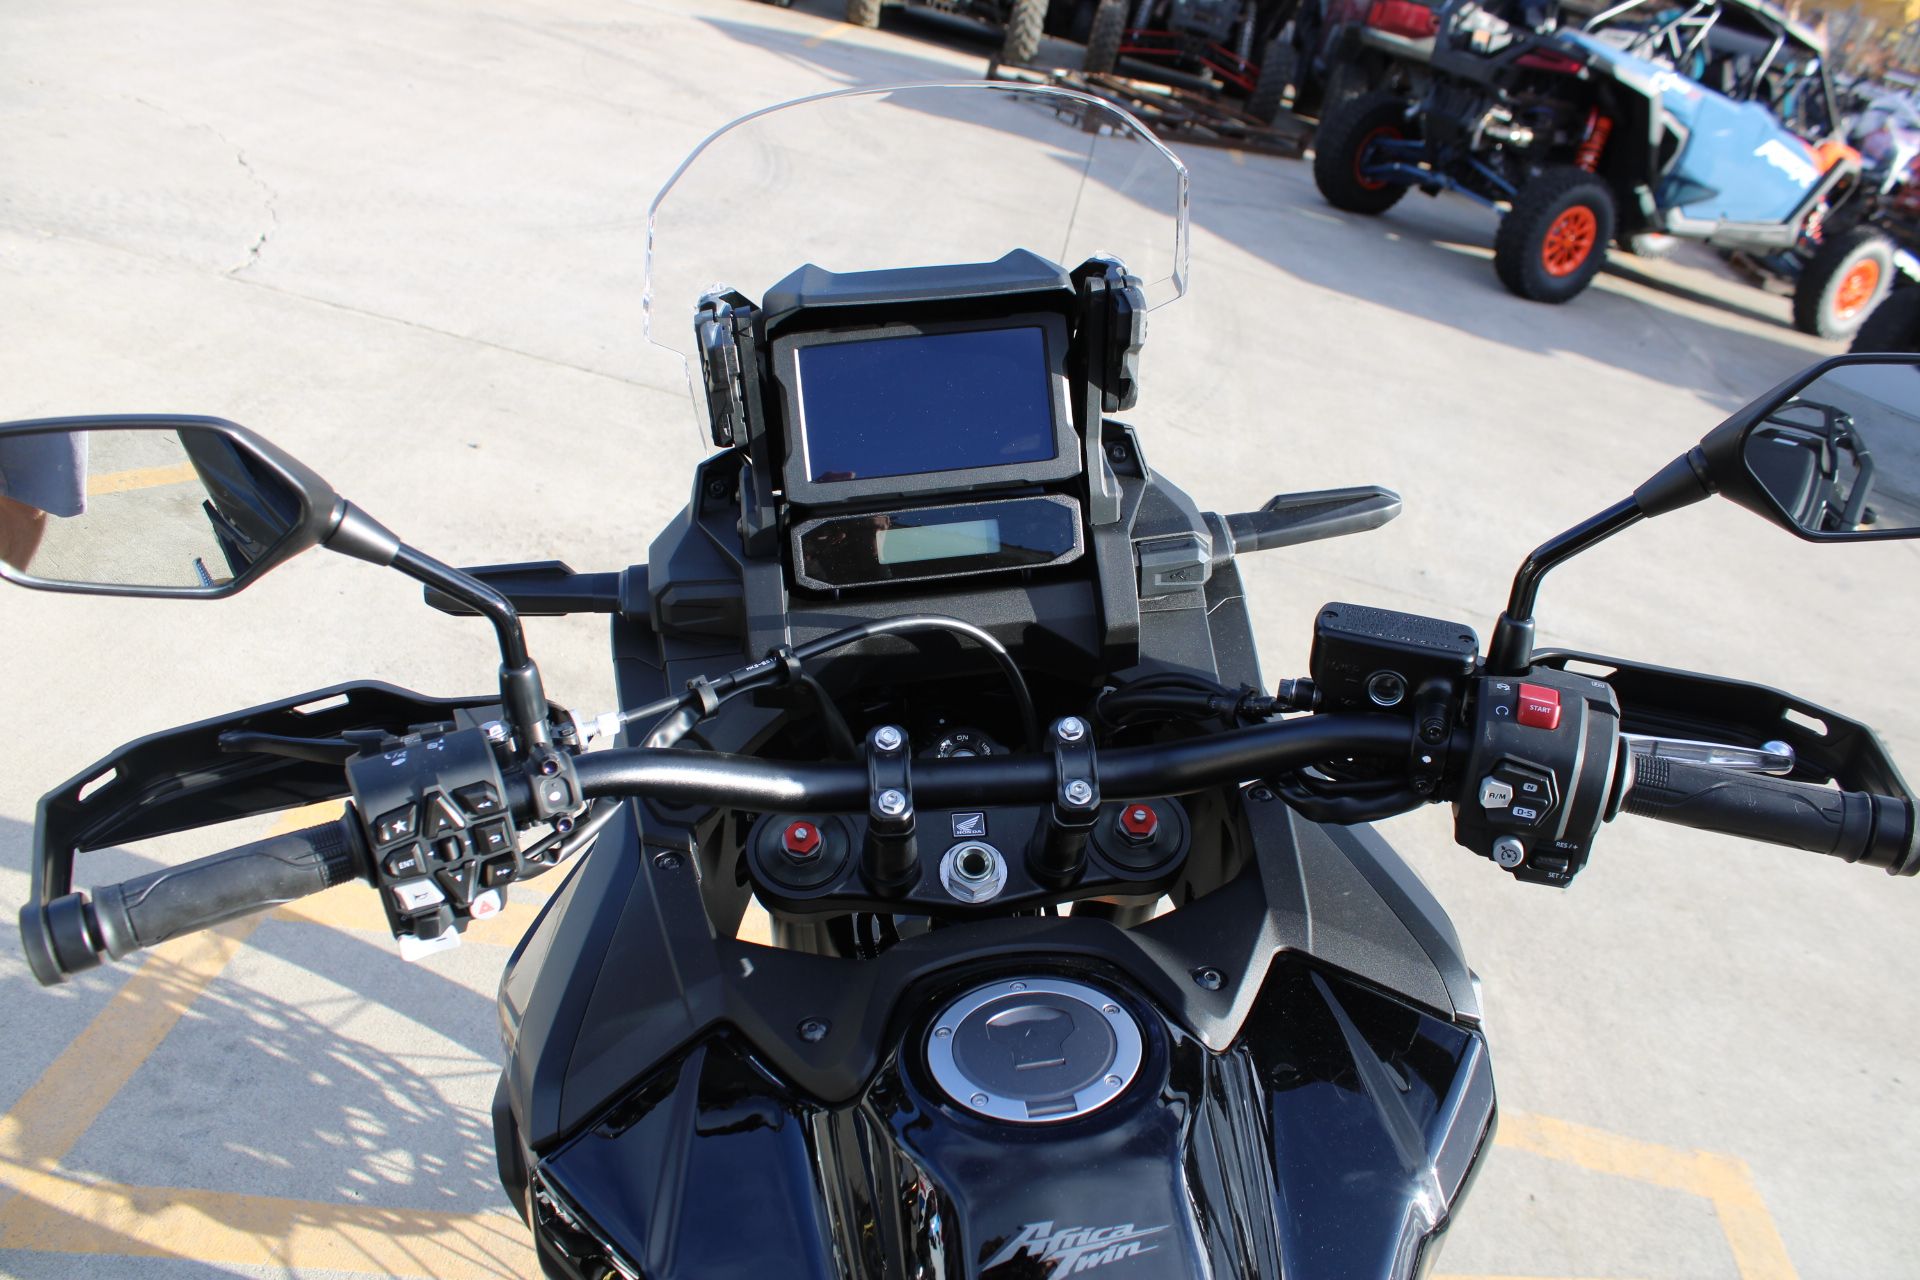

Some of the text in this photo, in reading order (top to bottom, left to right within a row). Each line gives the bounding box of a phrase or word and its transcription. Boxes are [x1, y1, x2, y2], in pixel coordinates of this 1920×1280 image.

[1529, 704, 1552, 714] START
[1488, 792, 1507, 800] A/M
[982, 1220, 1171, 1272] Africa
[1042, 1240, 1159, 1280] Twin
